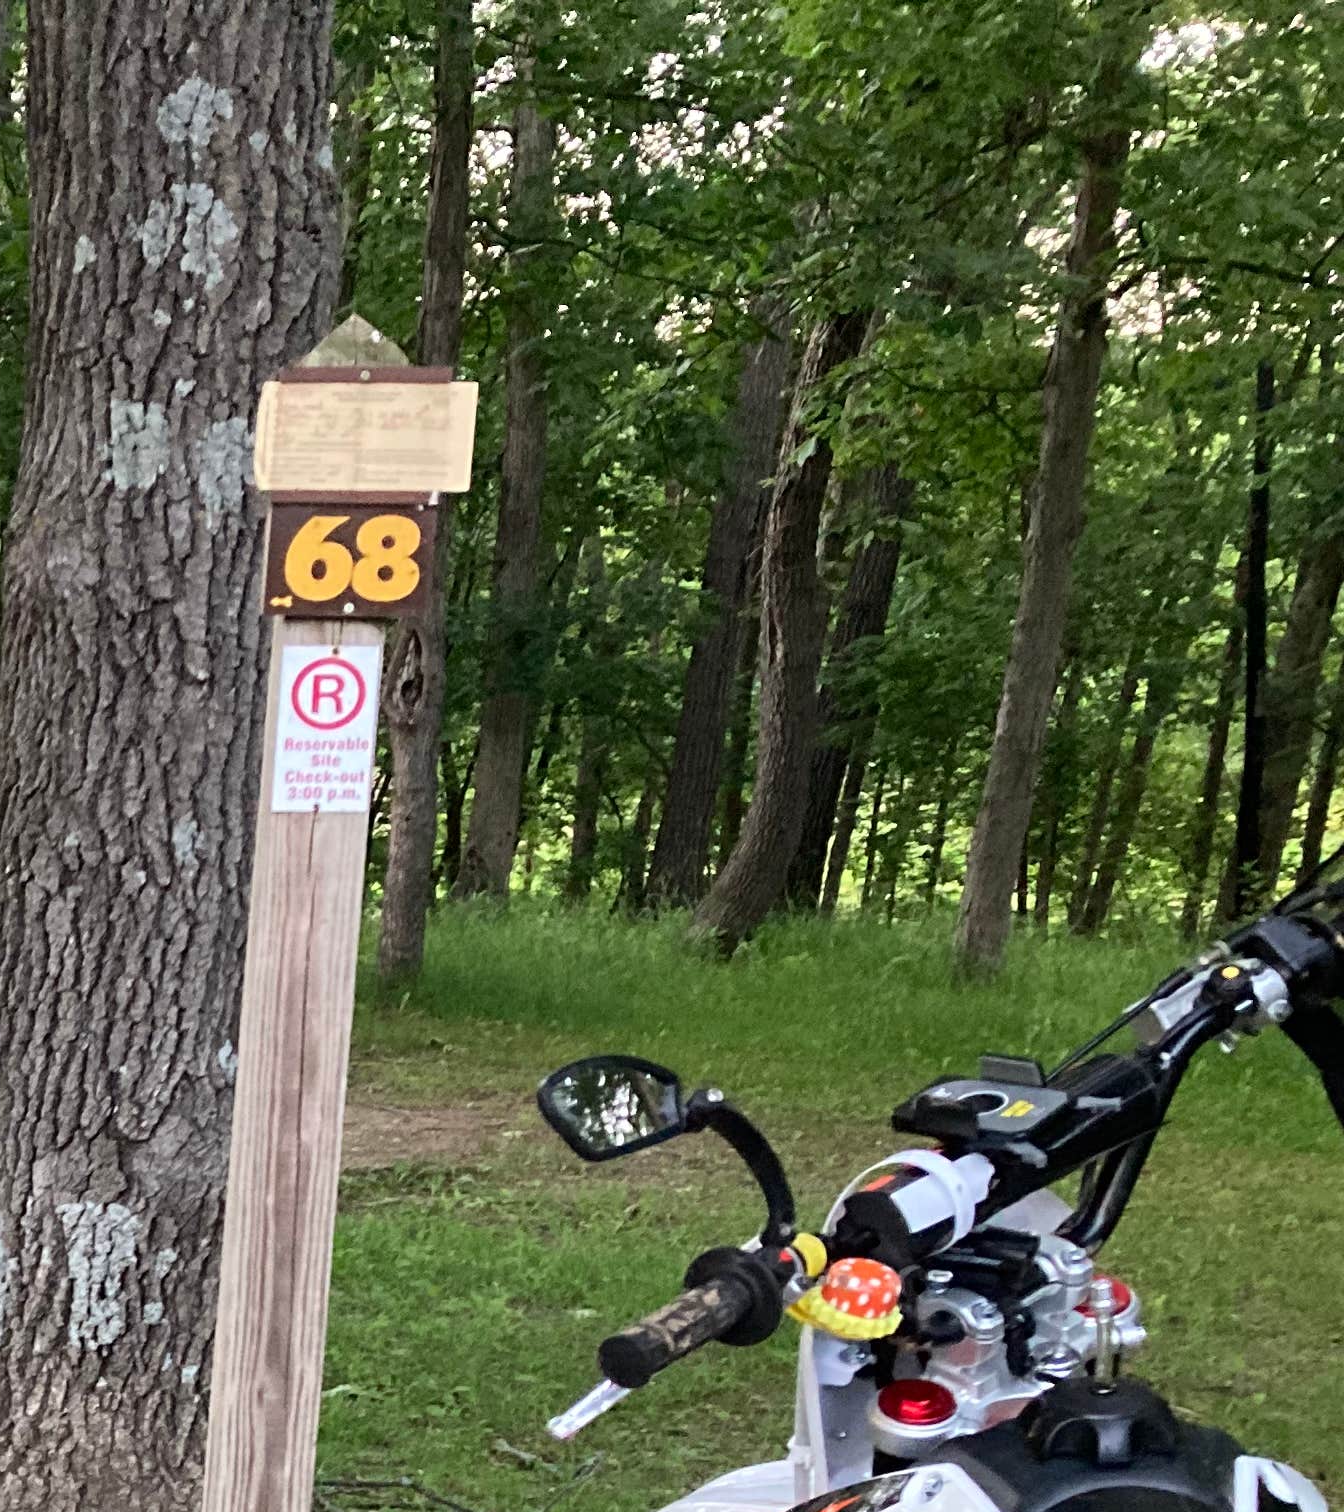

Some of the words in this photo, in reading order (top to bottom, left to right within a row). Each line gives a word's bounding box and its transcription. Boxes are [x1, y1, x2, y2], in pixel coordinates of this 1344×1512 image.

[284, 513, 422, 603] 68
[311, 673, 346, 715] R
[284, 737, 369, 751] Reservable
[311, 754, 341, 767] Site
[285, 770, 365, 784] Check-out
[288, 786, 322, 800] 3:00
[326, 789, 361, 803] p.m.
